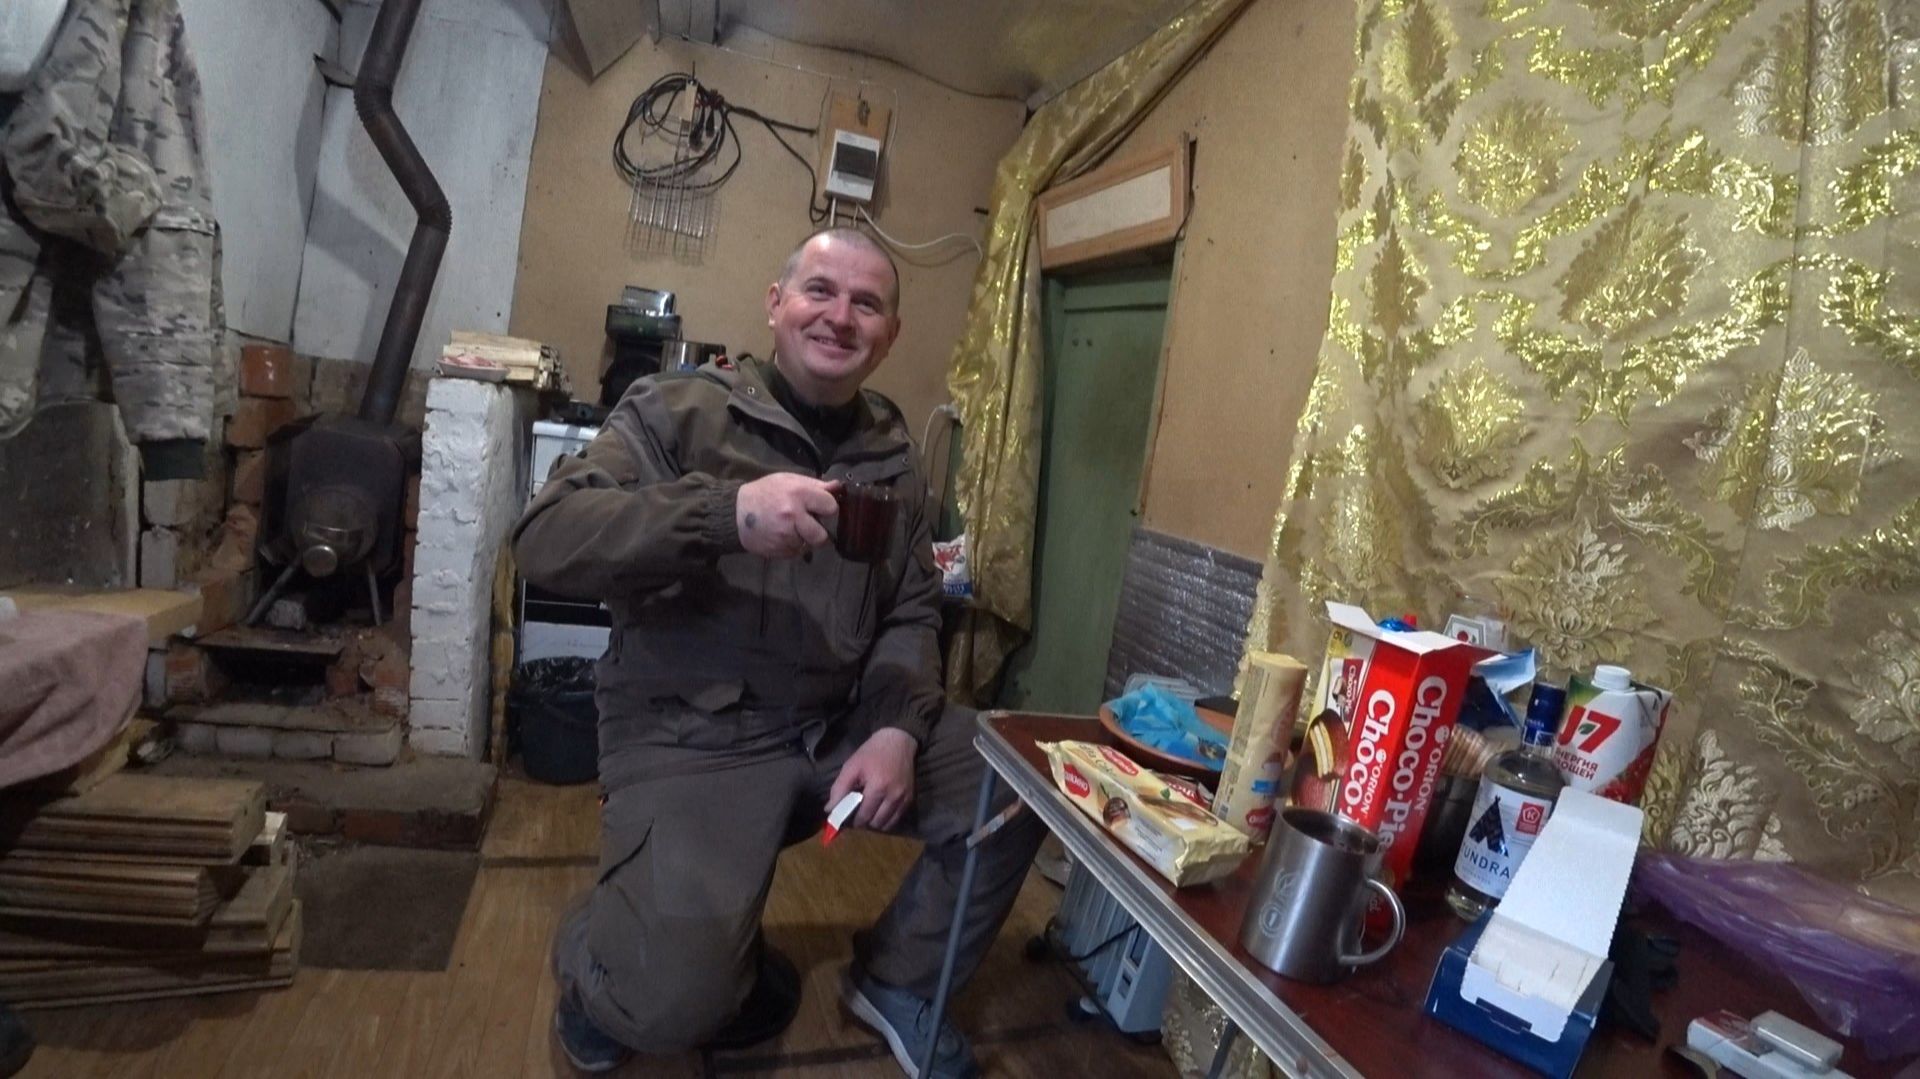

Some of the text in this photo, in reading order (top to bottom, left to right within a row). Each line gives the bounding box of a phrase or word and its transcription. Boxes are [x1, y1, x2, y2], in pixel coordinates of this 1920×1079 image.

[1558, 704, 1621, 754] J7
[1361, 765, 1382, 815] ORION
[1414, 748, 1442, 812] ORION
[1462, 845, 1510, 878] UNDRA
